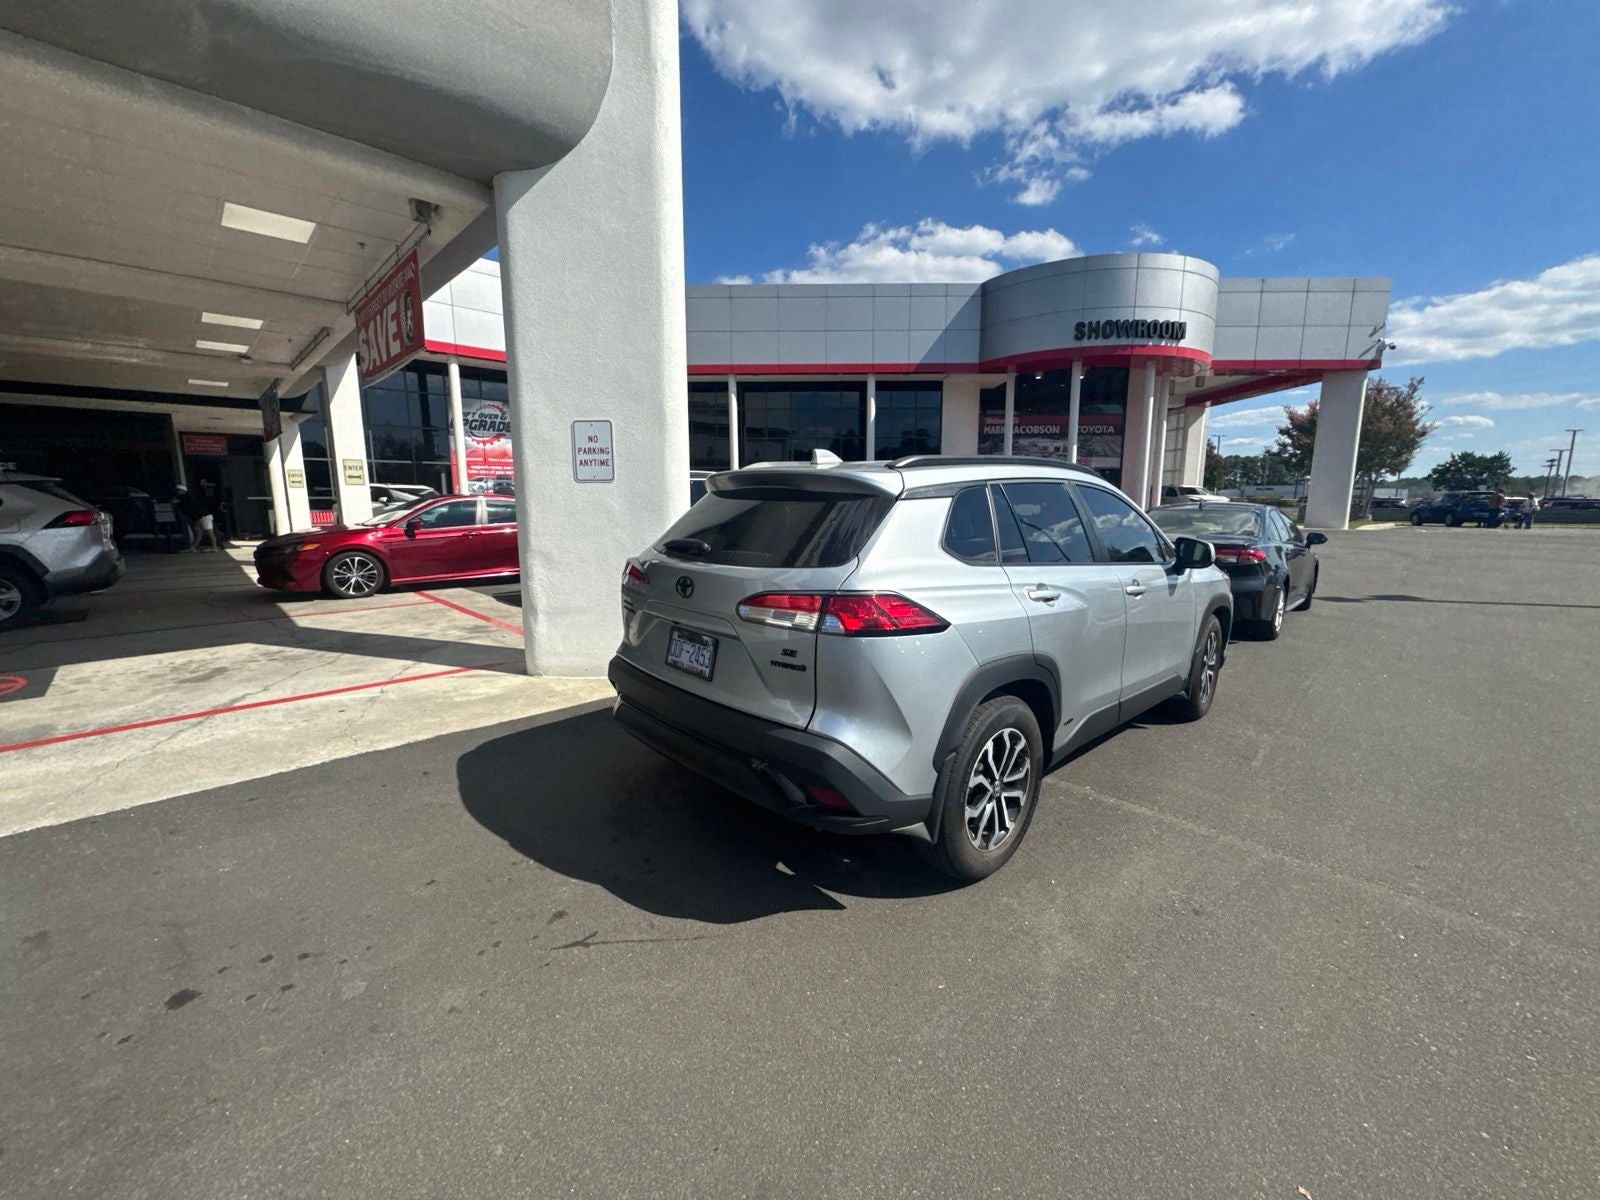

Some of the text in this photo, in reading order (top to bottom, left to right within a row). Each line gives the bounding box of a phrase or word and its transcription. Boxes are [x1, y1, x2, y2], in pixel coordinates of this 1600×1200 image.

[1074, 319, 1187, 341] SHOWROOM
[358, 300, 400, 374] SAVE
[1012, 425, 1060, 434] ACOBSON
[587, 435, 599, 443] NO
[577, 447, 610, 455] PARKING
[579, 459, 611, 467] ANYTIME
